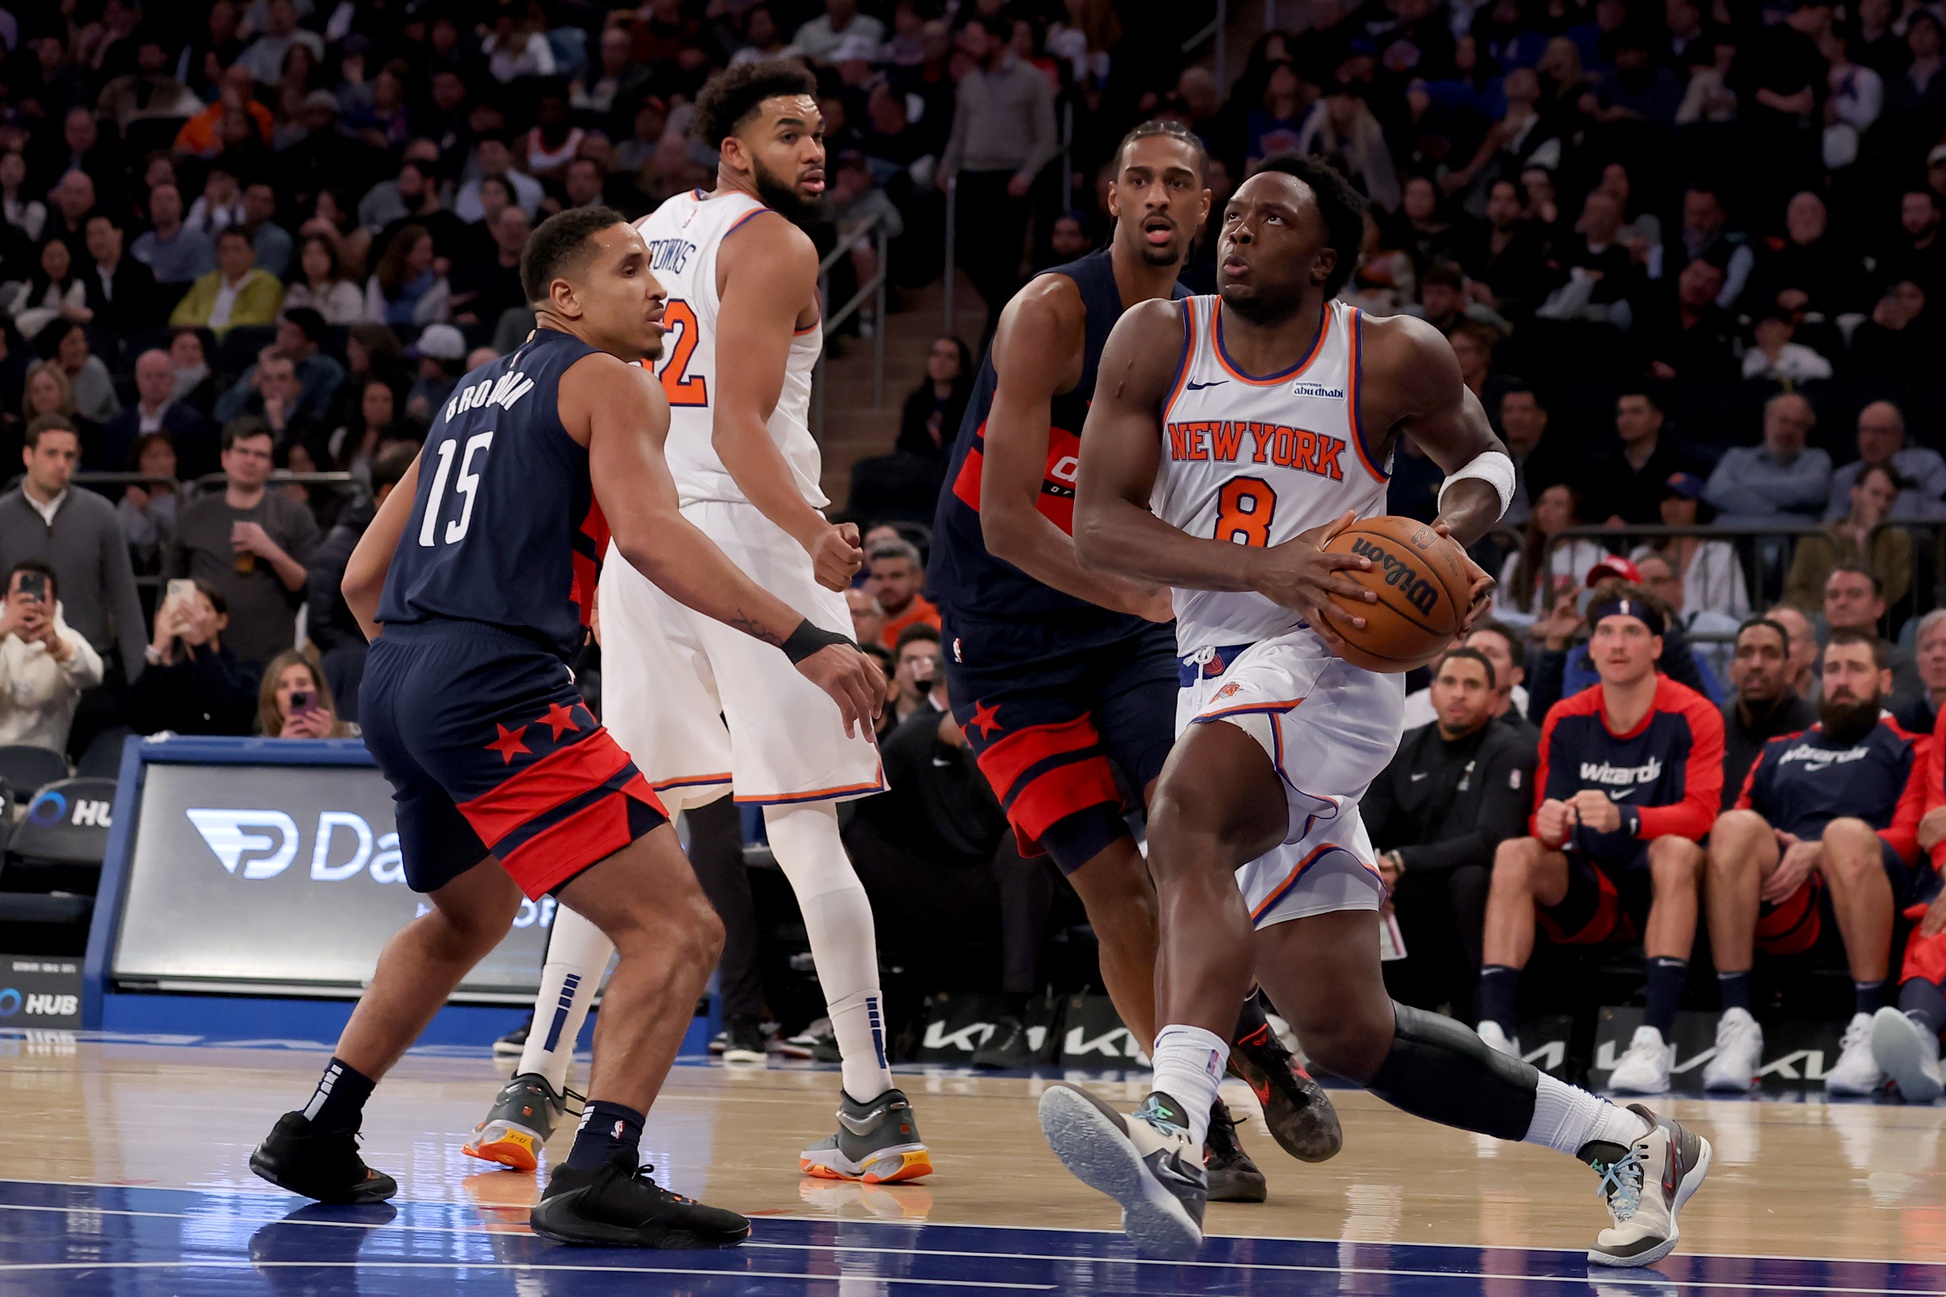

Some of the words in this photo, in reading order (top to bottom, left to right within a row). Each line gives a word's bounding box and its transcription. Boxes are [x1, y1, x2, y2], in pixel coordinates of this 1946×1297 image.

[649, 238, 697, 275] TOWNS
[641, 298, 709, 408] 2
[1294, 386, 1313, 396] abu
[1314, 388, 1344, 398] dhabi
[1167, 421, 1247, 462] NEW
[1249, 421, 1347, 483] YORK
[418, 431, 494, 547] 15
[1213, 475, 1278, 549] 8
[1351, 537, 1439, 618] Wilson
[71, 799, 113, 828] HU
[25, 993, 79, 1016] HUB
